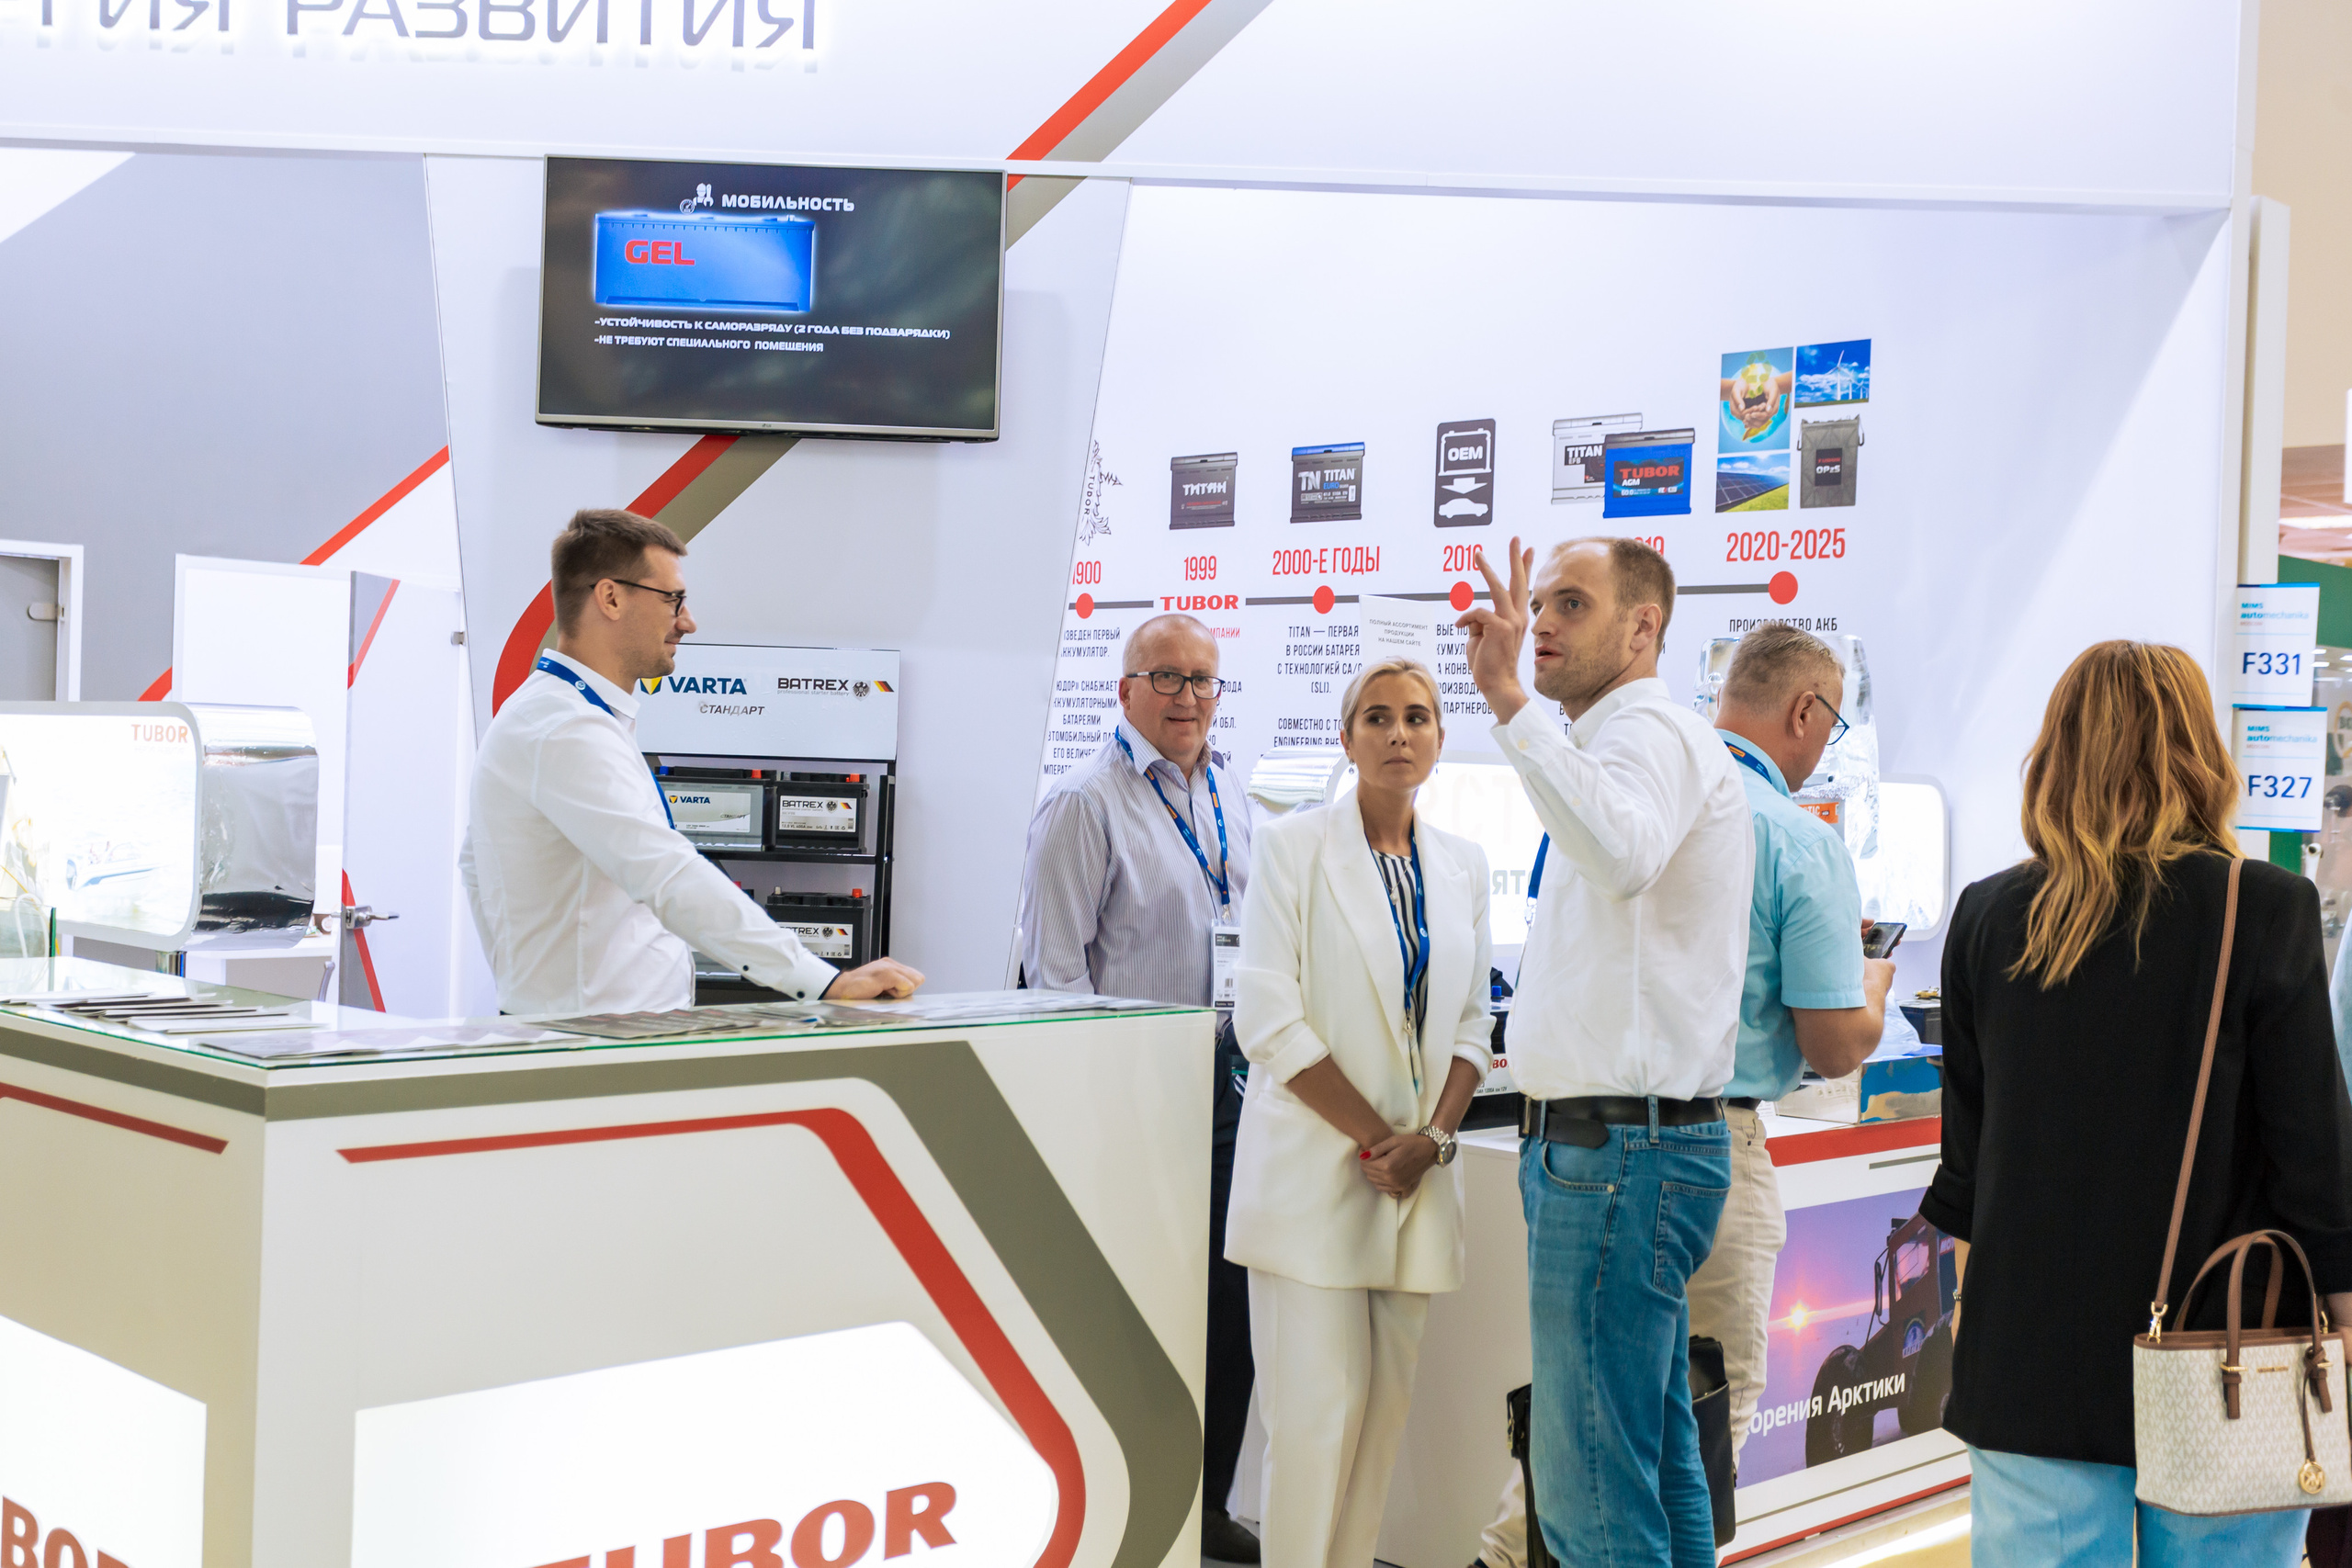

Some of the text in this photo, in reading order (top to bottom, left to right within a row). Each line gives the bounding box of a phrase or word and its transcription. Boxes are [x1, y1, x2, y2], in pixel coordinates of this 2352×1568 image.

[721, 194, 855, 211] МОБИЛЬНОСТЬ
[625, 240, 695, 266] GEL
[594, 317, 951, 340] -УСТОЙЧИВОСТЬ К САМОРАЗРЯДУ (2 ГОДА БЕЗ ПОДЗАРЯДКИ)
[594, 335, 824, 352] -НЕ ТРЕБУЮТ СПЕЦИАЛЬНОГО ПОМЕЩЕНИЯ
[1448, 446, 1483, 462] OEM
[1566, 445, 1603, 458] TITAN
[1324, 468, 1355, 482] TITAN
[1620, 465, 1680, 480] TUBOR
[1622, 478, 1641, 487] AGM
[1084, 475, 1095, 515] TUDOR
[1726, 527, 1846, 562] 2020-2025
[1272, 546, 1380, 576] 2000-Е ГОДЫ
[1183, 556, 1217, 581] 1999
[1159, 594, 1239, 612] TUBOR
[1816, 617, 1838, 631] АКБ
[1093, 627, 1120, 640] ПЕРВЫЙ
[1289, 626, 1310, 637] TITAN
[1329, 626, 1359, 637] ПЕРВАЯ
[1061, 646, 1109, 658] ККУМУЛЯТОР.
[1286, 644, 1360, 656] В РОССИИ БАТАРЕЯ
[1278, 663, 1282, 674] С
[1285, 661, 1340, 674] ТЕХНОЛОГИЕЙ
[2242, 652, 2301, 675] F331
[668, 676, 747, 694] VARTA
[777, 677, 849, 691] BATREX
[1080, 681, 1118, 692] СНАБЖАЕТ
[699, 704, 765, 716] СТАНДАРТ
[1063, 715, 1102, 726] БАТАРЕЯМИ
[1220, 717, 1237, 728] ОБЛ.
[1278, 718, 1323, 730] СОВМЕСТНО
[130, 724, 188, 743] TUBOR
[1054, 748, 1065, 759] ЕГО
[2248, 774, 2312, 798] F327
[680, 795, 710, 805] VARTA
[782, 800, 823, 808] BATREX
[780, 926, 820, 935] TREX
[1747, 1373, 1905, 1437] орения Арктики
